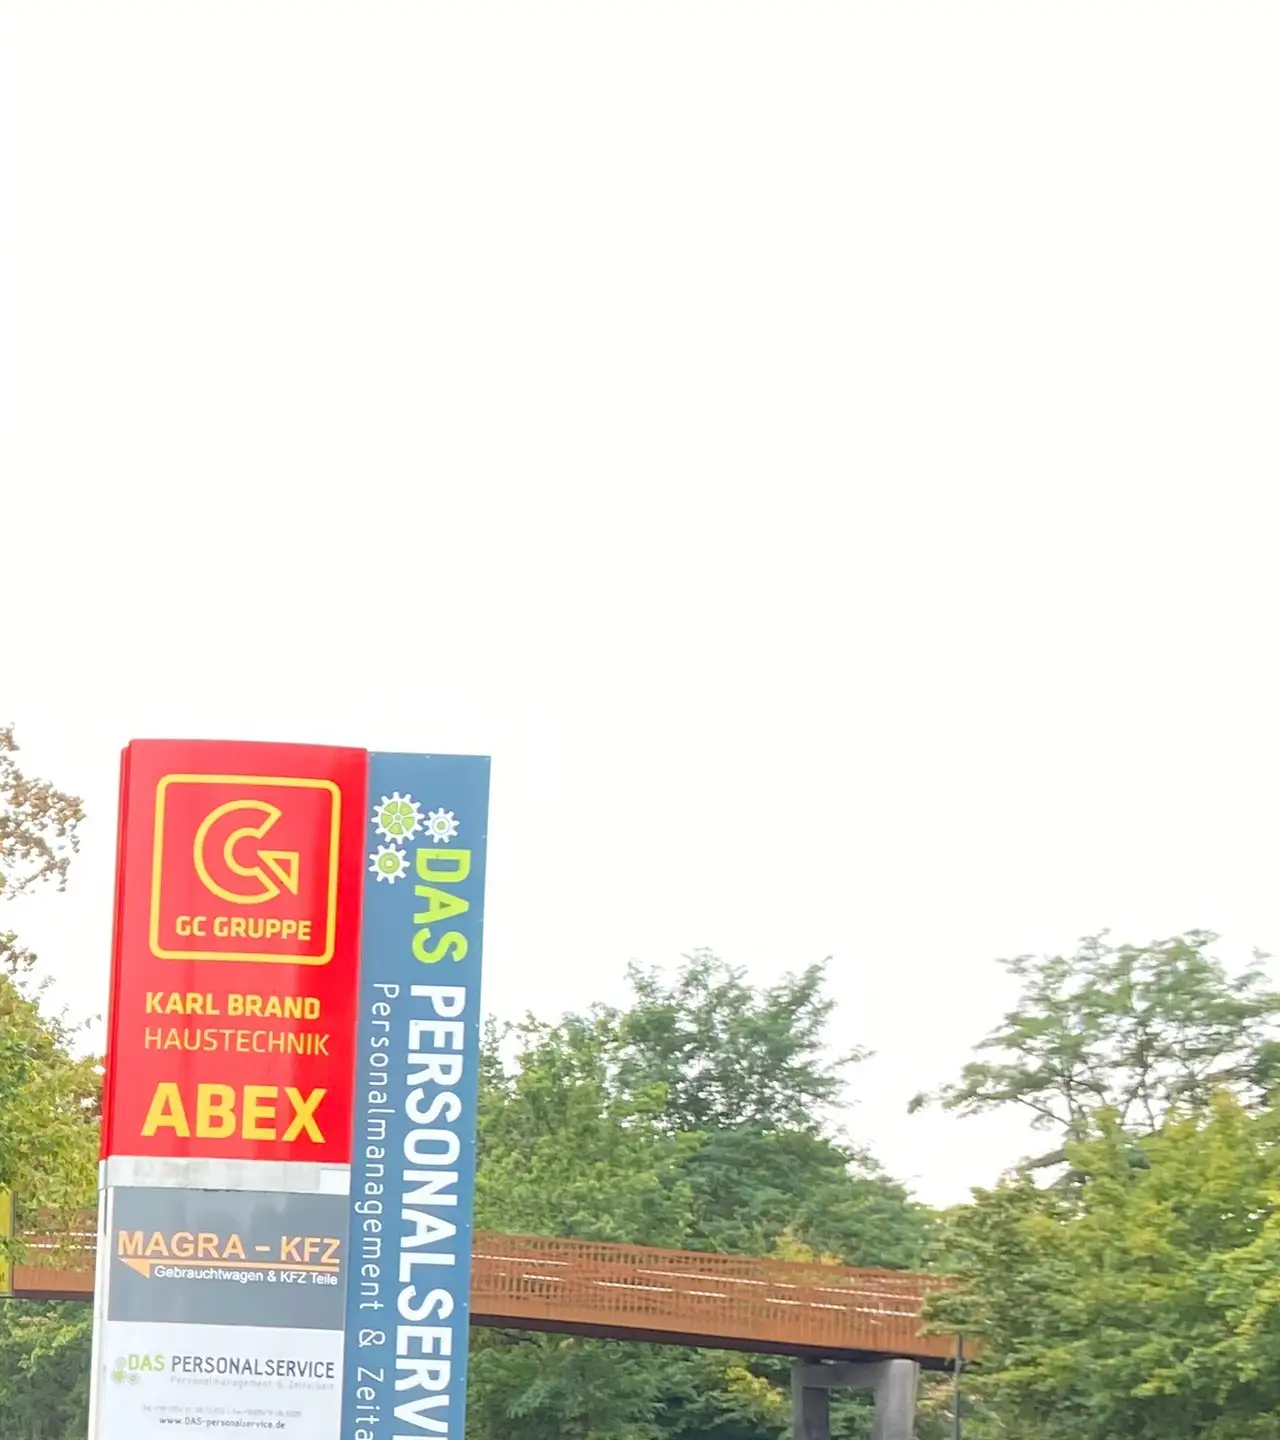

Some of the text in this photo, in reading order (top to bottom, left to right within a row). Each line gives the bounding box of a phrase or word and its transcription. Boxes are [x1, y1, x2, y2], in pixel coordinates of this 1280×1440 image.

[411, 848, 472, 964] DAS
[175, 915, 313, 941] GC GRUPPE
[145, 991, 321, 1020] KARL BRAND
[144, 1027, 330, 1057] HAUSTECHNIK
[140, 1082, 328, 1144] ABEX
[354, 983, 400, 1310] Personalmanagement
[117, 1230, 247, 1260] MAGRA
[281, 1236, 340, 1264] KFZ
[154, 1266, 338, 1286] Gebrauchtwagen & KFZ Teile
[358, 1328, 386, 1348] &
[128, 1354, 335, 1379] DAS PERSONALSERVICE
[159, 1416, 286, 1429] www.DAS-personalservice.de
